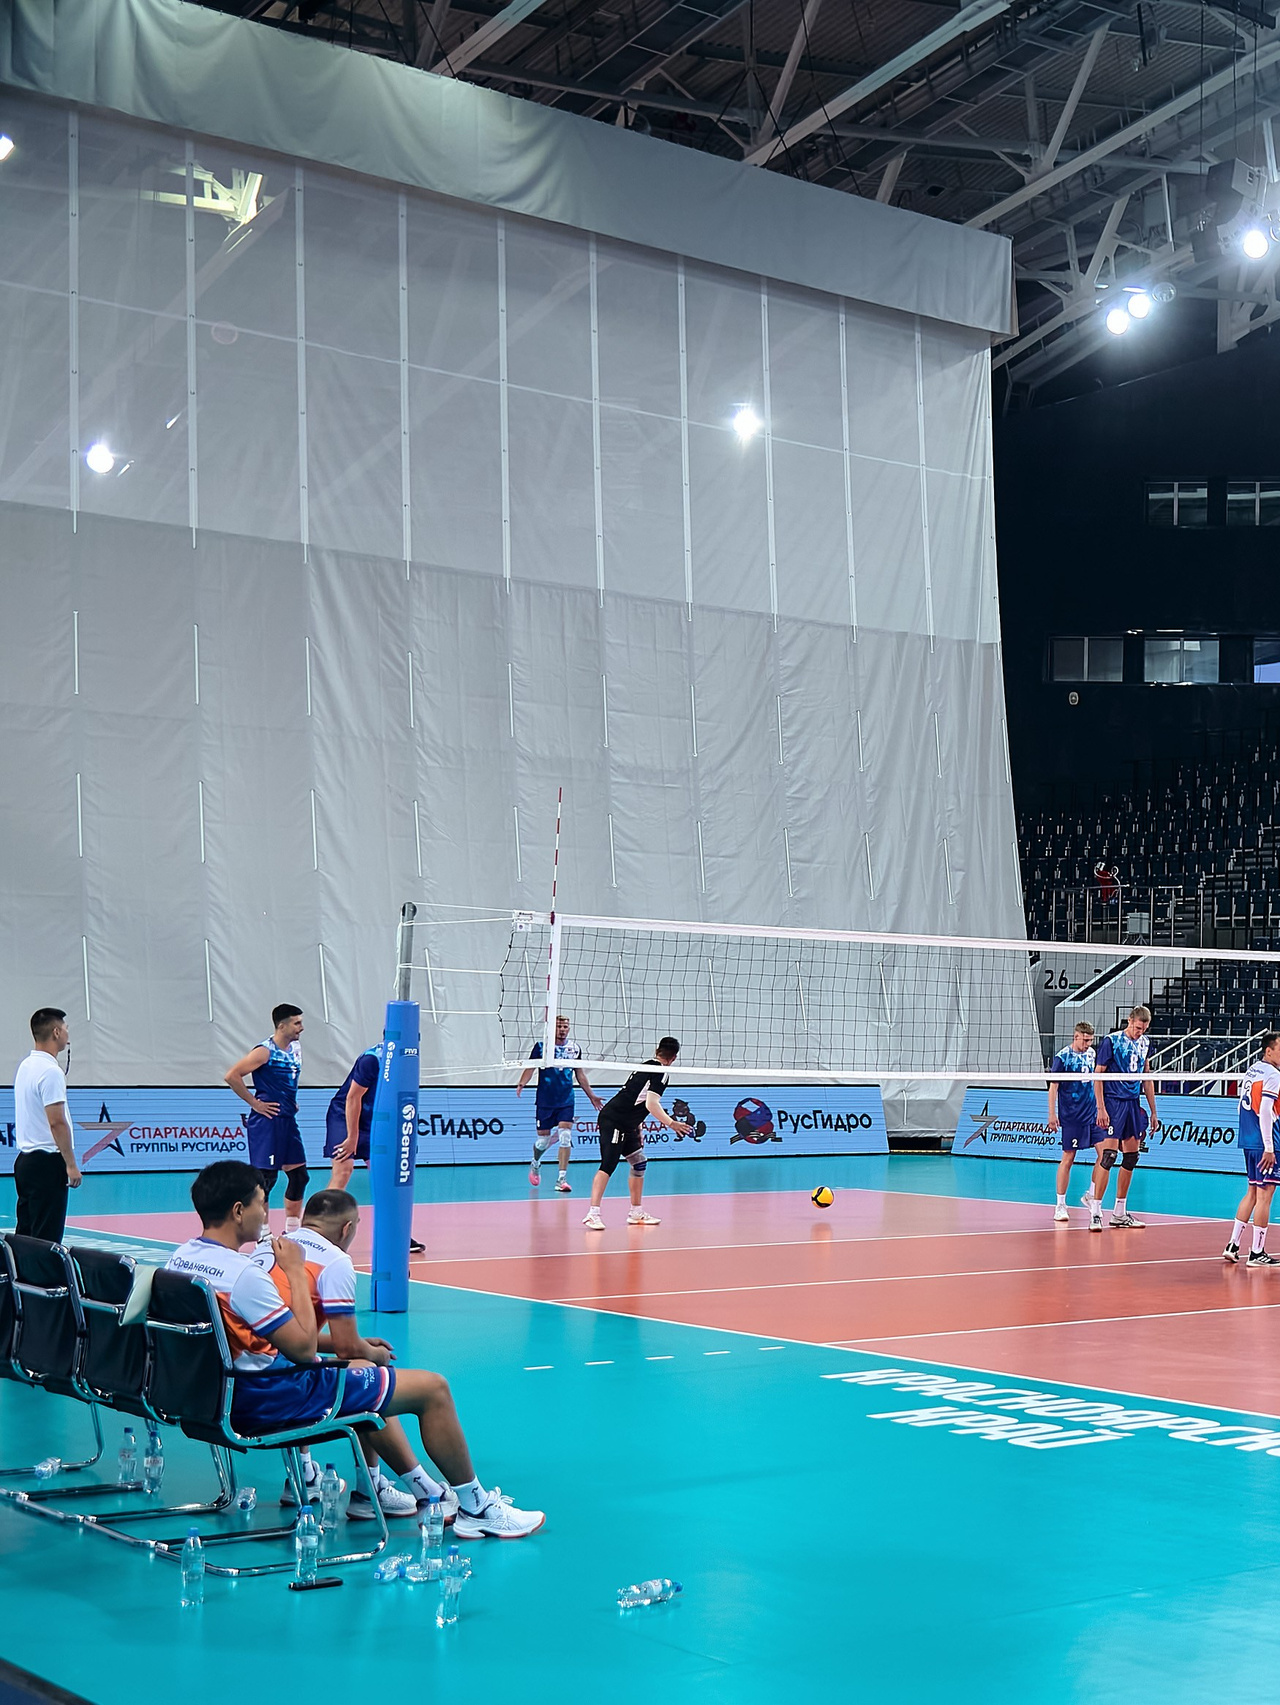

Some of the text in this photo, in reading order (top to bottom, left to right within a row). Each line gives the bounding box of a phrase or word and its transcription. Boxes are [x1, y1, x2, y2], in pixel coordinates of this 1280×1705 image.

[1044, 969, 1068, 990] 2.6
[1129, 1054, 1139, 1072] 8
[417, 1114, 504, 1140] сГидро
[777, 1110, 872, 1134] РусГидро
[993, 1120, 1057, 1135] СПАРТАКИАД
[129, 1126, 245, 1140] СПАРТАКИАДА
[1108, 1126, 1114, 1135] 8
[130, 1141, 247, 1153] ГРУППЫ РУСГИДРО
[990, 1133, 1056, 1146] ГРУППЫ РУСГИДРО
[1072, 1138, 1078, 1148] 2
[400, 1121, 414, 1183] Senoh
[269, 1154, 275, 1166] 1
[866, 1406, 1135, 1449] КРАЙ
